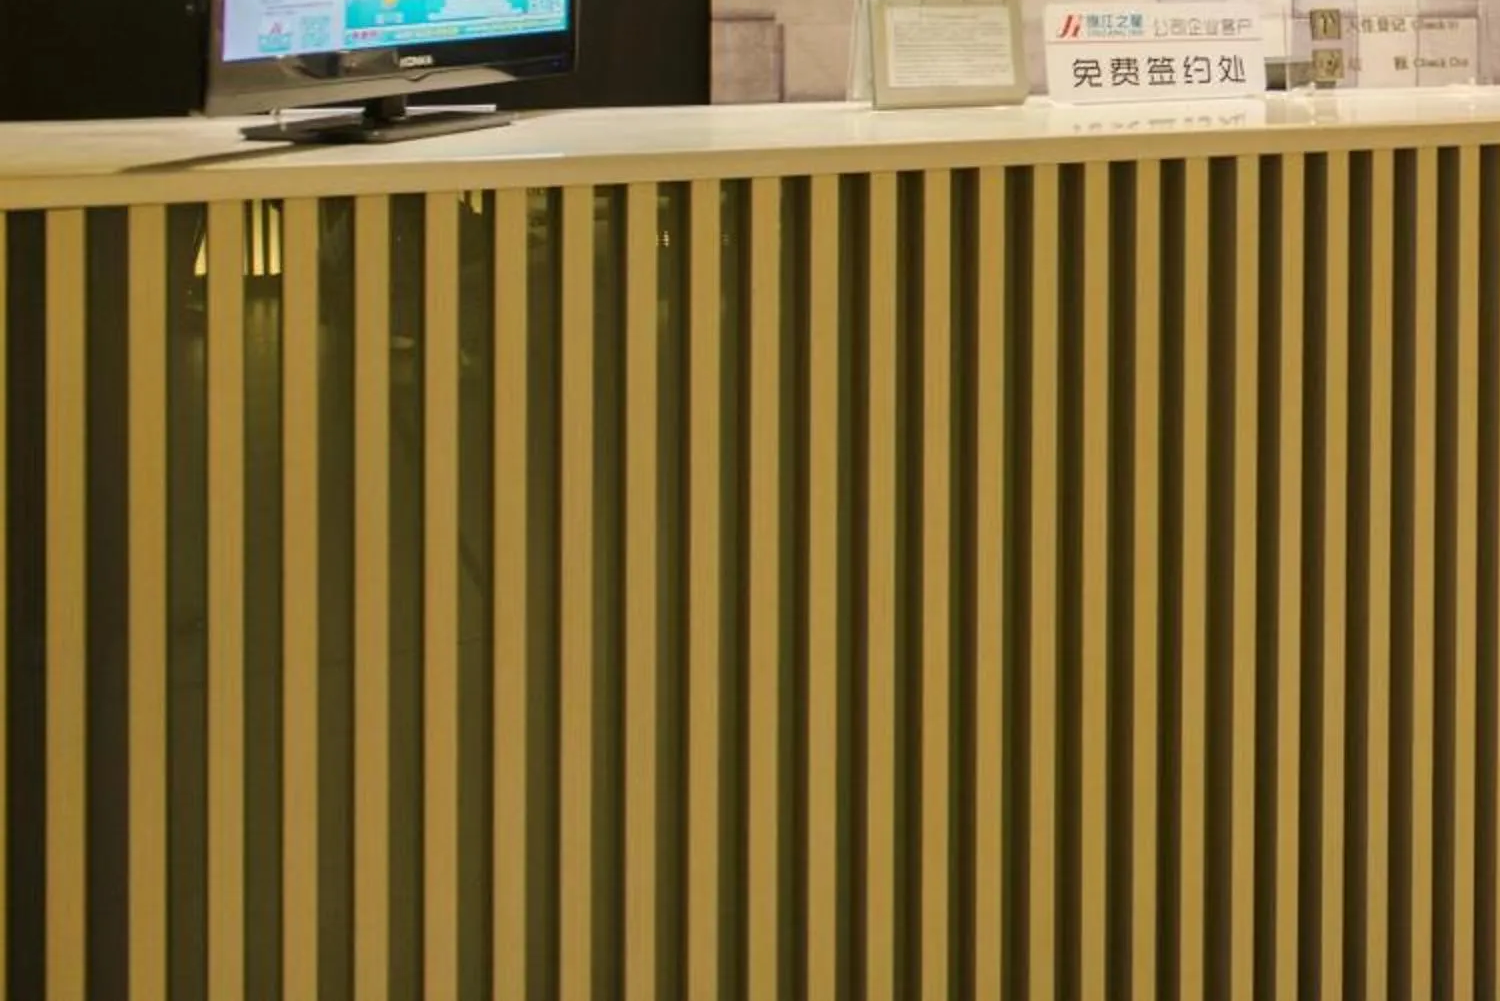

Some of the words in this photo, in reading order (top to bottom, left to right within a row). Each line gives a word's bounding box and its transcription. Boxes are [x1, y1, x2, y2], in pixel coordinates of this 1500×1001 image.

[1153, 17, 1251, 37] 公司企业客户
[1072, 54, 1247, 88] 免费签约处
